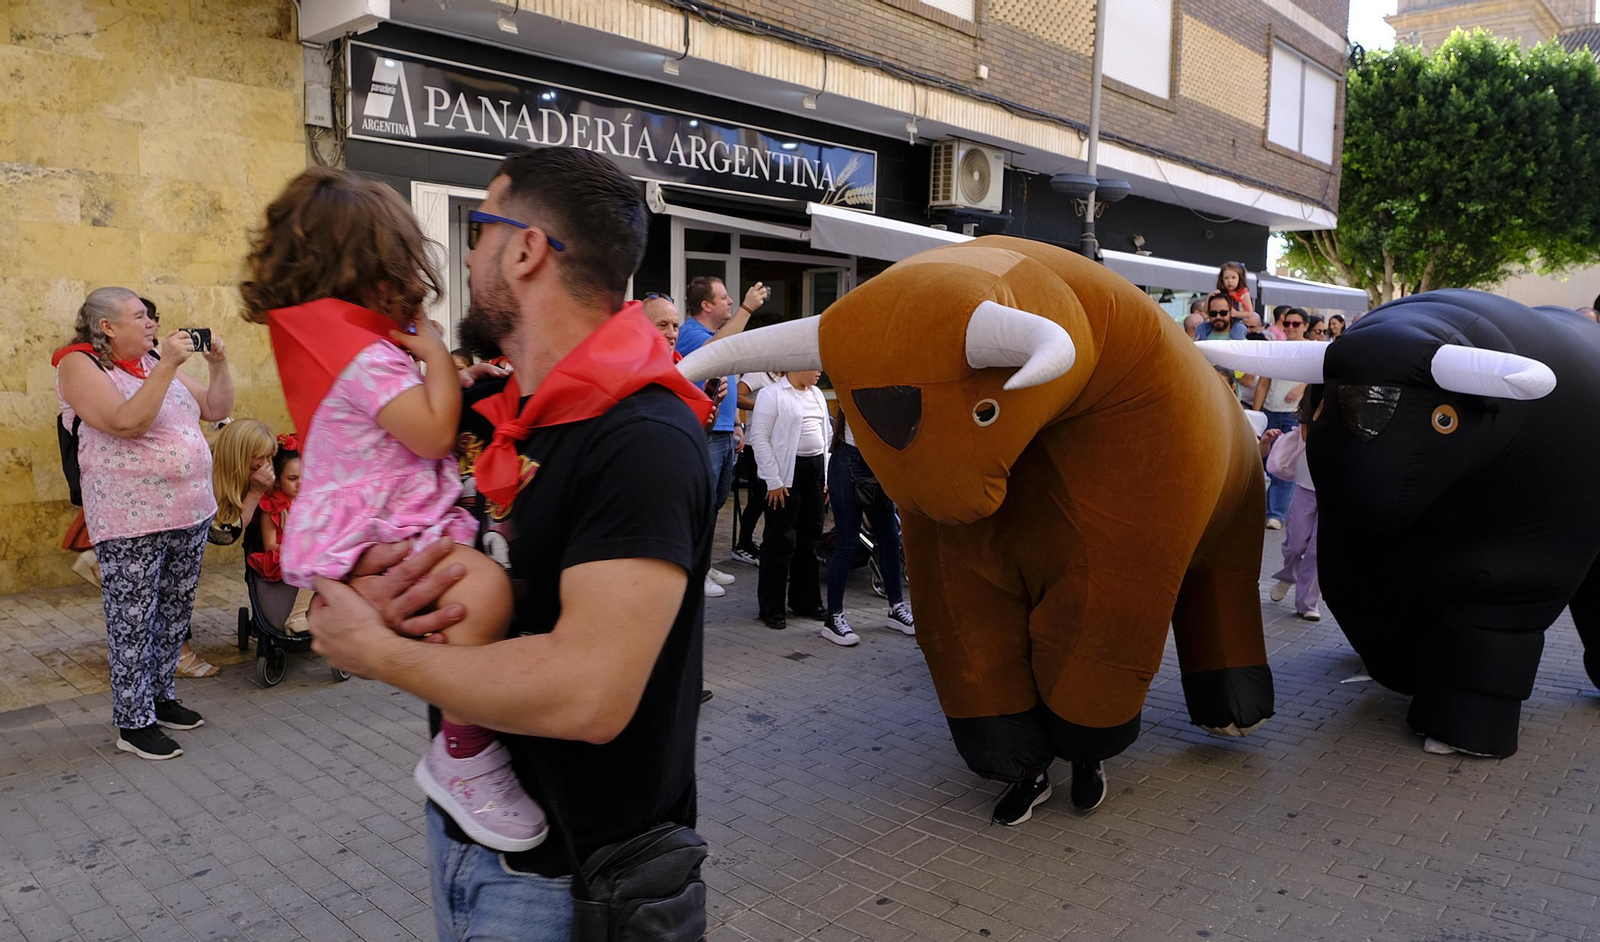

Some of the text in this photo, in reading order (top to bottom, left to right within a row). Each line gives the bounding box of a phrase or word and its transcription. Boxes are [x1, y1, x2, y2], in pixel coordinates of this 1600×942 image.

[361, 118, 410, 136] ARGENTINA
[423, 85, 836, 192] PANADERÍA ARGENTINA
